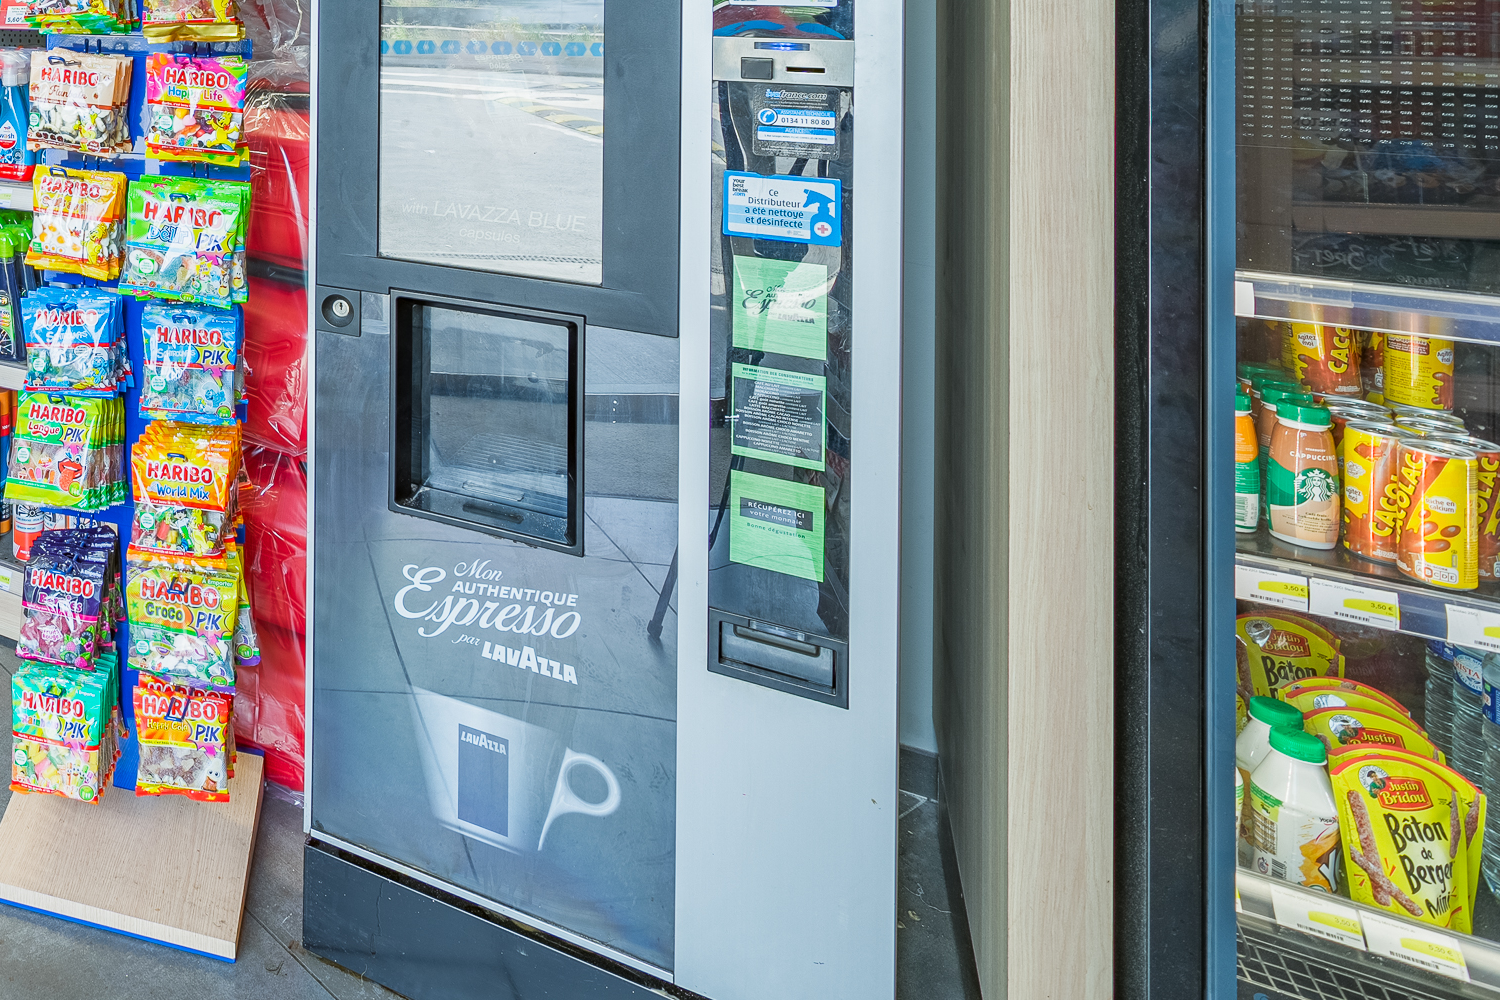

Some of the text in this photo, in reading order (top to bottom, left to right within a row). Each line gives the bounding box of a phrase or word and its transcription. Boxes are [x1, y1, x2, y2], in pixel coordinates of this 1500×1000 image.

[41, 67, 98, 87] HARIBO
[165, 68, 229, 89] HARIBO
[203, 88, 223, 101] Life
[41, 177, 100, 198] HARIBO
[769, 189, 779, 197] Ce
[748, 196, 801, 208] Distributeur
[145, 201, 222, 228] HARIBO
[401, 200, 587, 232] with LAVAZZA BLUE
[768, 208, 804, 219] nettoyé
[760, 217, 803, 229] désinfecté
[459, 226, 521, 243] capsules
[36, 309, 97, 326] HARIBO
[156, 327, 222, 346] HARIBO
[29, 404, 85, 424] HARIBO
[28, 421, 60, 437] Langue
[1290, 451, 1335, 461] CAPPUCCINO
[147, 462, 213, 484] HARIBO
[156, 484, 209, 500] World Mix
[748, 501, 791, 516] RÉCUPÉREZ
[750, 510, 802, 525] votre monnaie
[453, 558, 504, 582] Mon
[32, 570, 93, 597] HARIBO
[207, 580, 233, 588] Emporter
[1284, 584, 1299, 592] 3,50
[140, 577, 219, 609] HARIBO
[394, 564, 582, 638] Espresso
[452, 581, 579, 607] AUTHENTIQUE
[1371, 603, 1387, 611] 3,50
[1272, 632, 1300, 644] Justin
[1264, 640, 1304, 654] Bridou
[451, 632, 579, 685] par LAVAZZA
[22, 691, 85, 718] HARIBO
[142, 696, 217, 720] HARIBO
[170, 720, 188, 732] Cola
[460, 730, 507, 756] LAVAZZA
[1361, 732, 1396, 745] Justin
[1388, 781, 1419, 791] Justin
[1382, 790, 1425, 804] Bridou
[1384, 813, 1448, 854] Bâton
[1422, 846, 1433, 860] de
[1400, 854, 1455, 894] Berger
[1425, 888, 1452, 920] Mini
[1334, 917, 1351, 926] 3,50
[1428, 944, 1446, 954] 5,30
